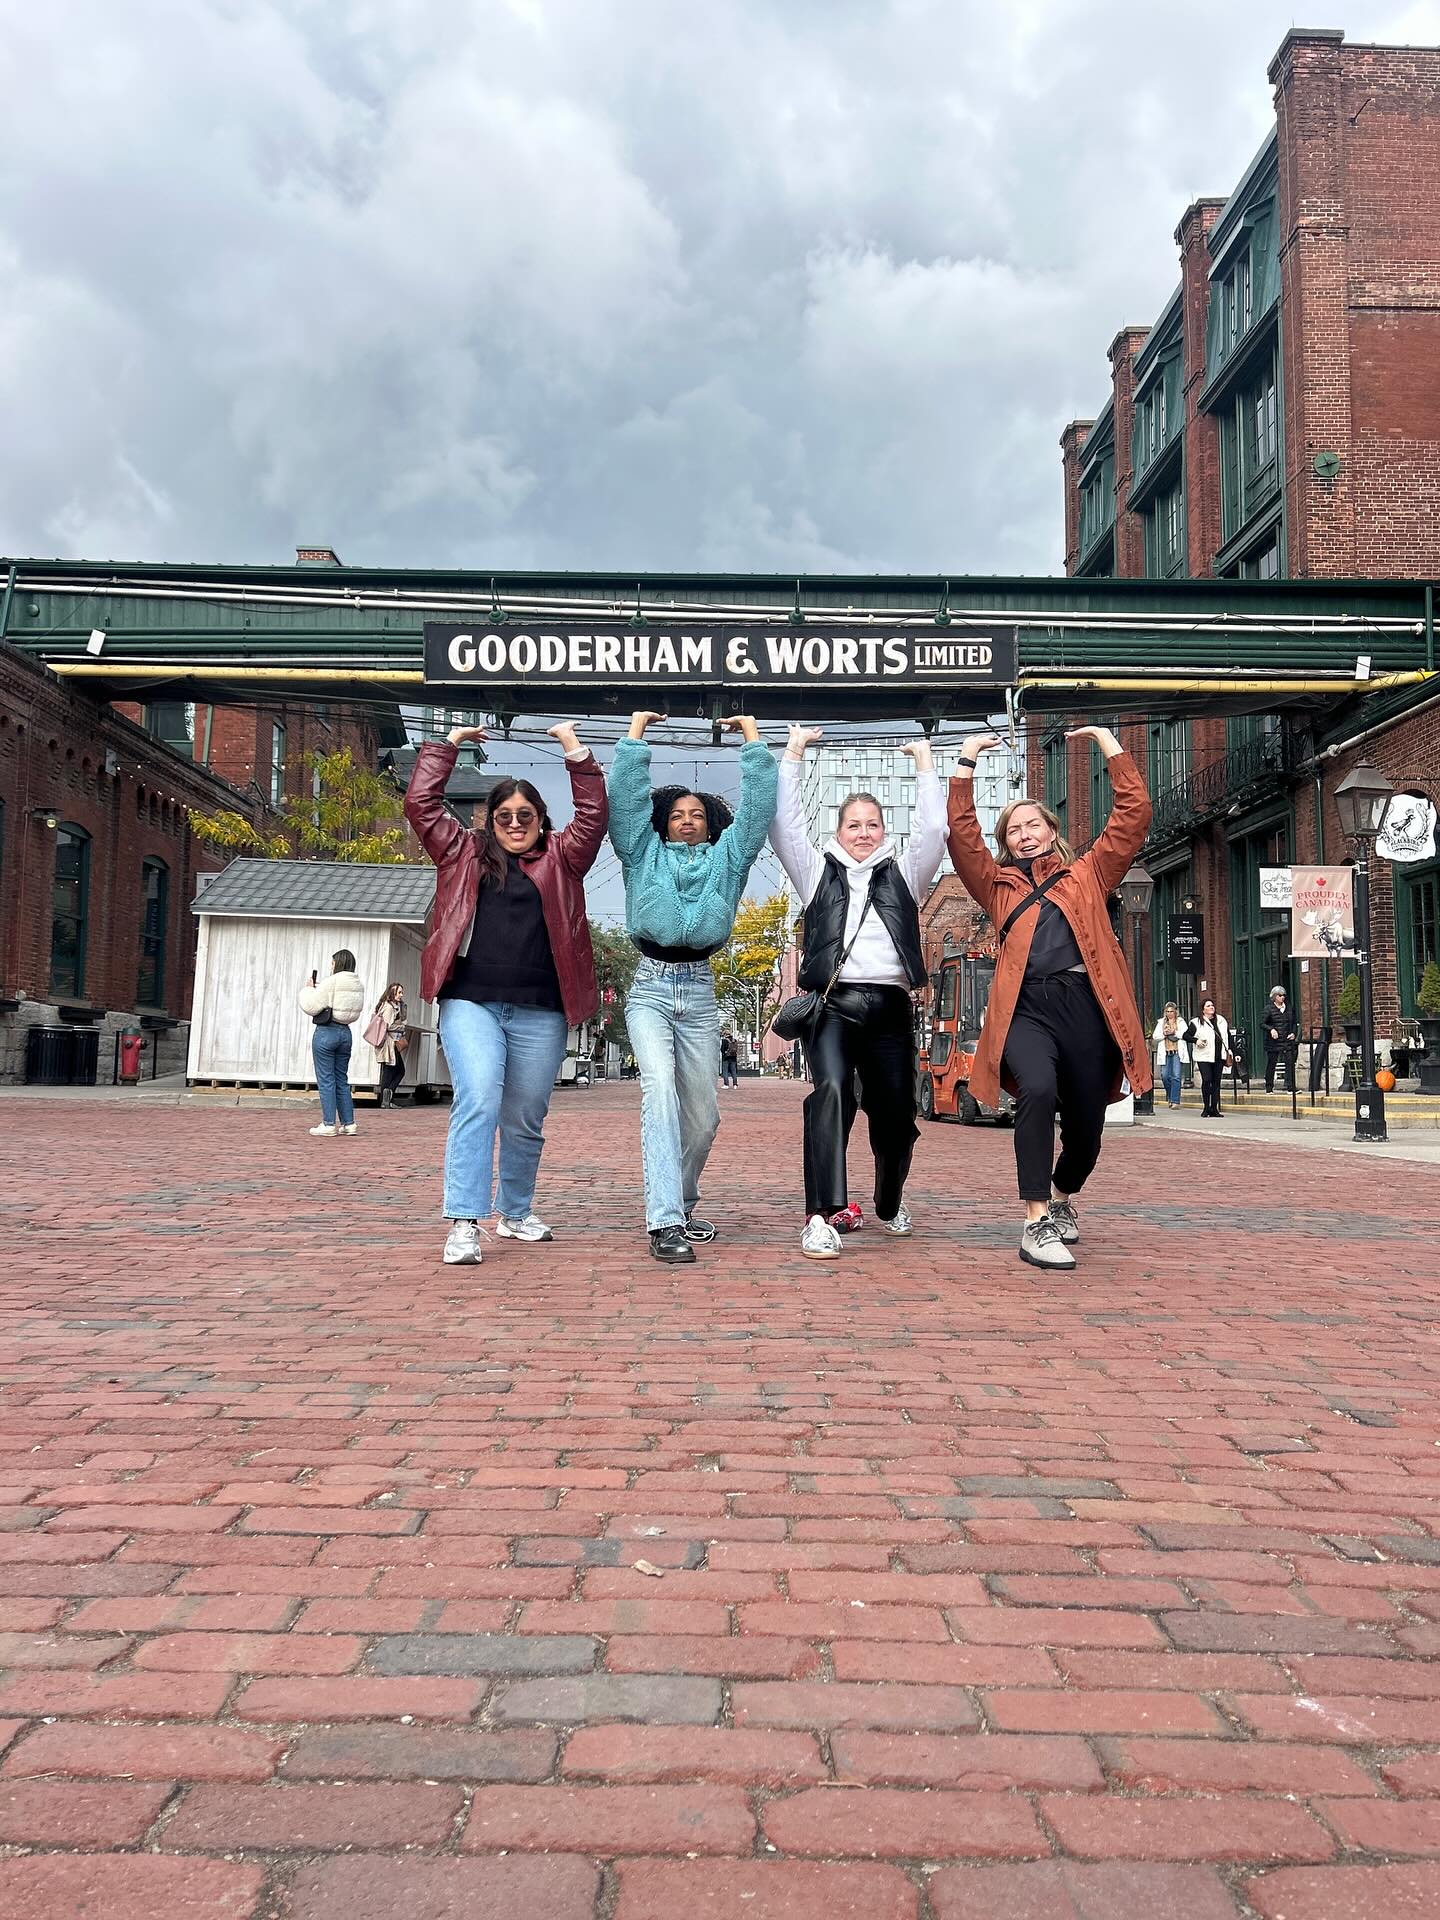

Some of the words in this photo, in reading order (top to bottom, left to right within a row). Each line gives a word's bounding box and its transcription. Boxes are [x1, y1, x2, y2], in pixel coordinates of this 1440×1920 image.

[448, 635, 712, 673] GOODERHAM
[726, 637, 759, 674] &
[765, 638, 908, 674] WORTS
[914, 645, 992, 666] LIMITED
[1297, 890, 1348, 900] PROUDLY
[1296, 900, 1350, 909] CANADIAN
